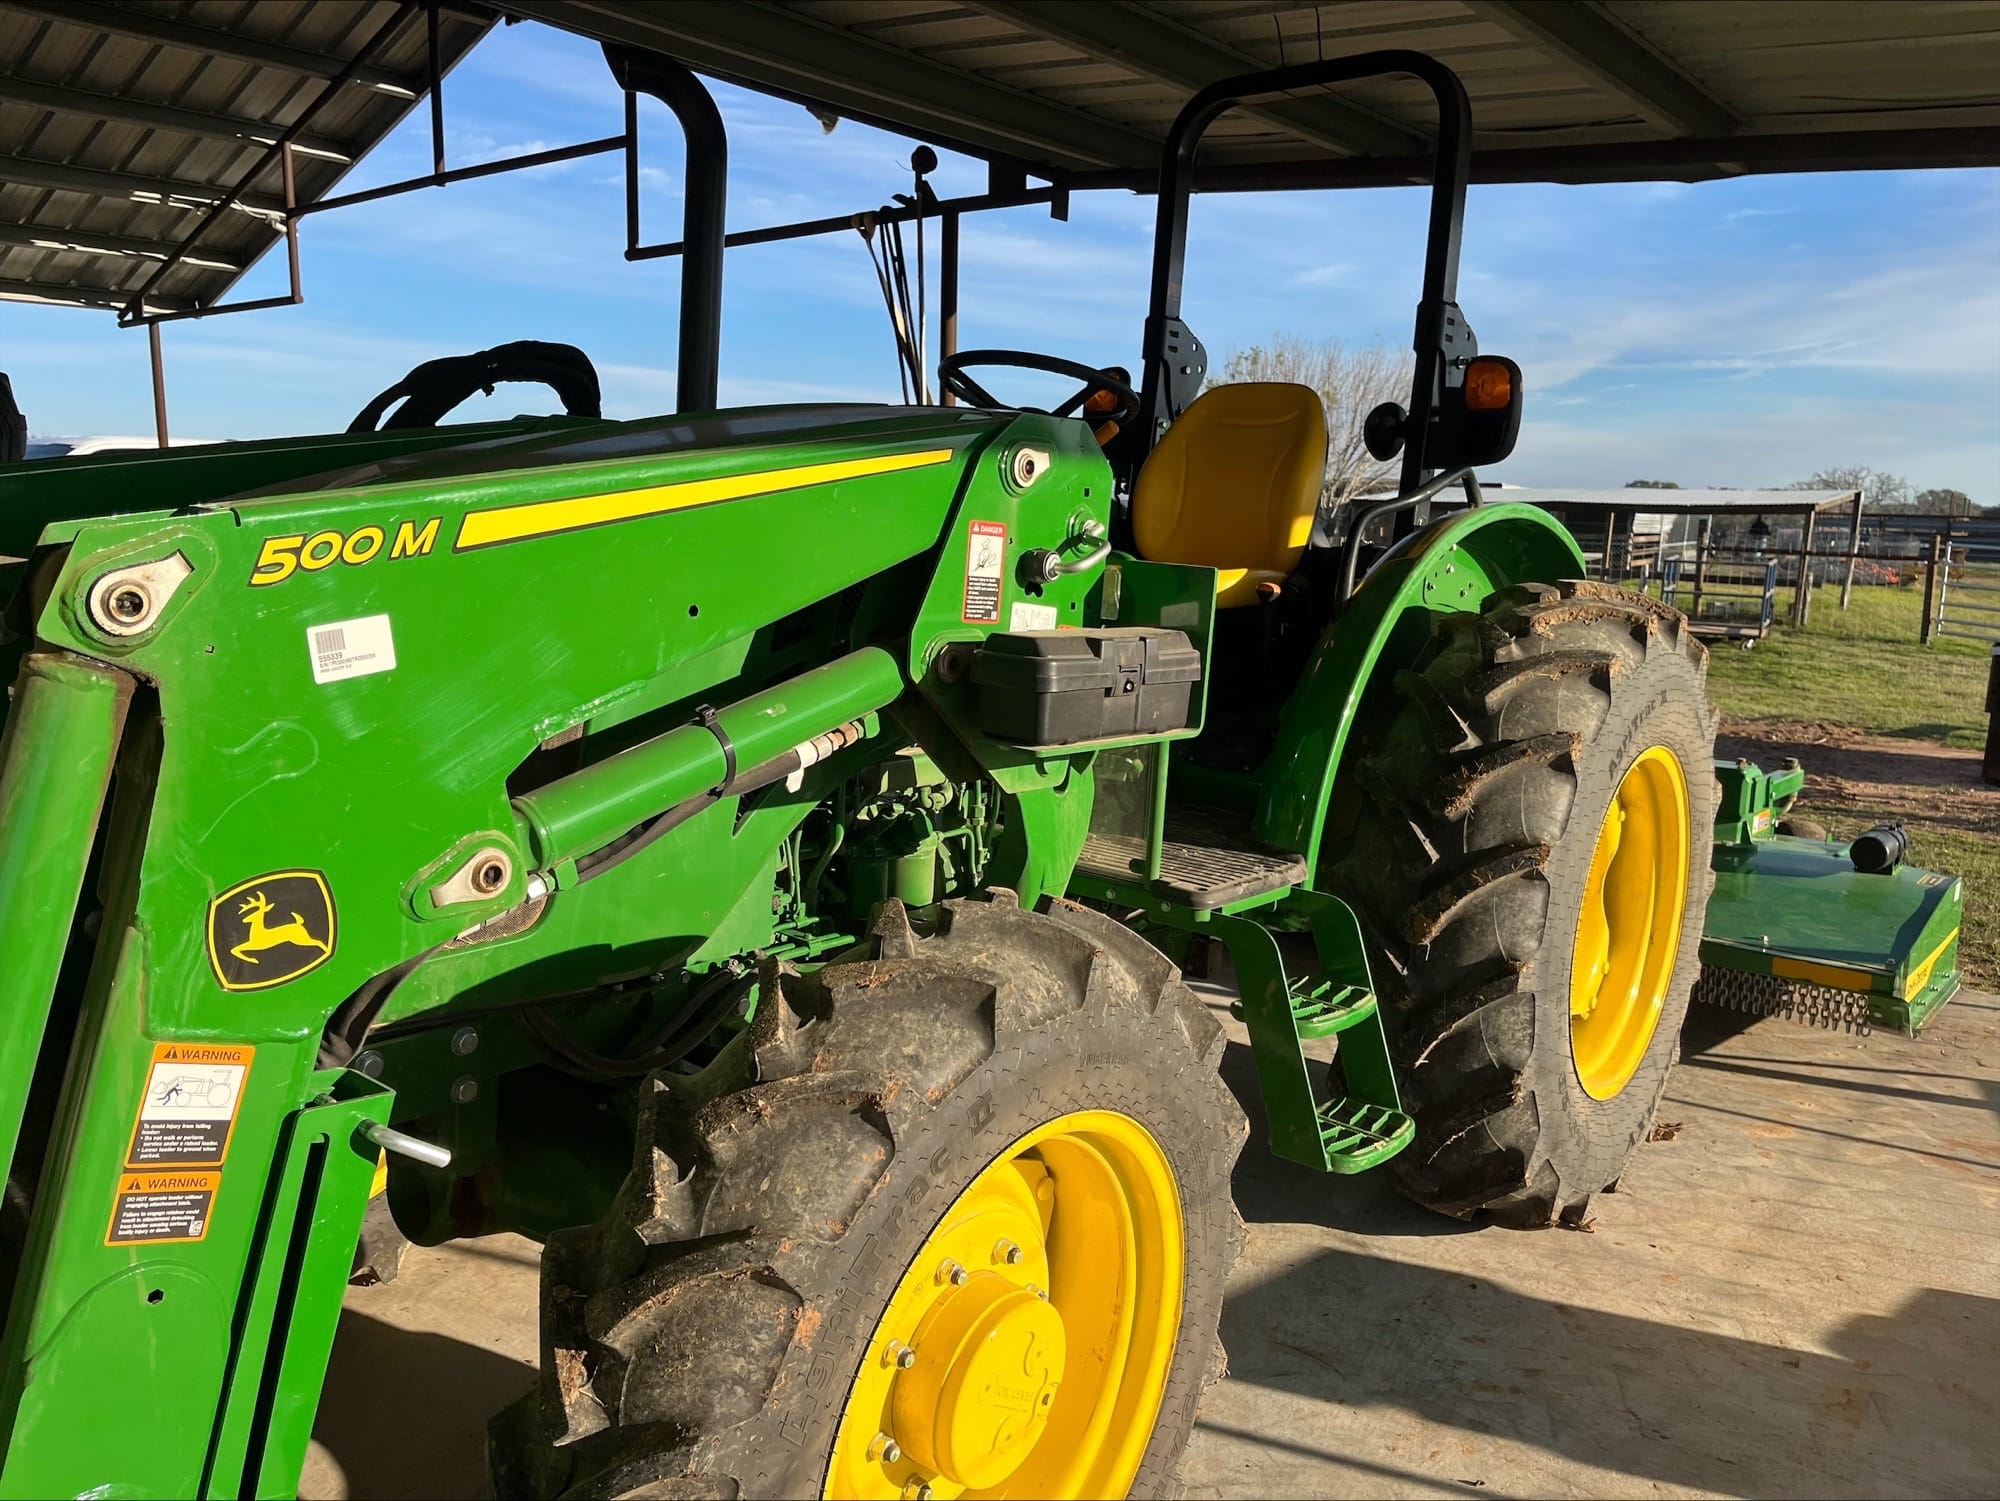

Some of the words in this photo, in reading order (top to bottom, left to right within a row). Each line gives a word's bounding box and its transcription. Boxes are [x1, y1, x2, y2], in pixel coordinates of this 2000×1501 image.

[980, 525, 1003, 534] DANGER
[182, 1049, 242, 1061] WARNING
[148, 1178, 208, 1189] WARNING
